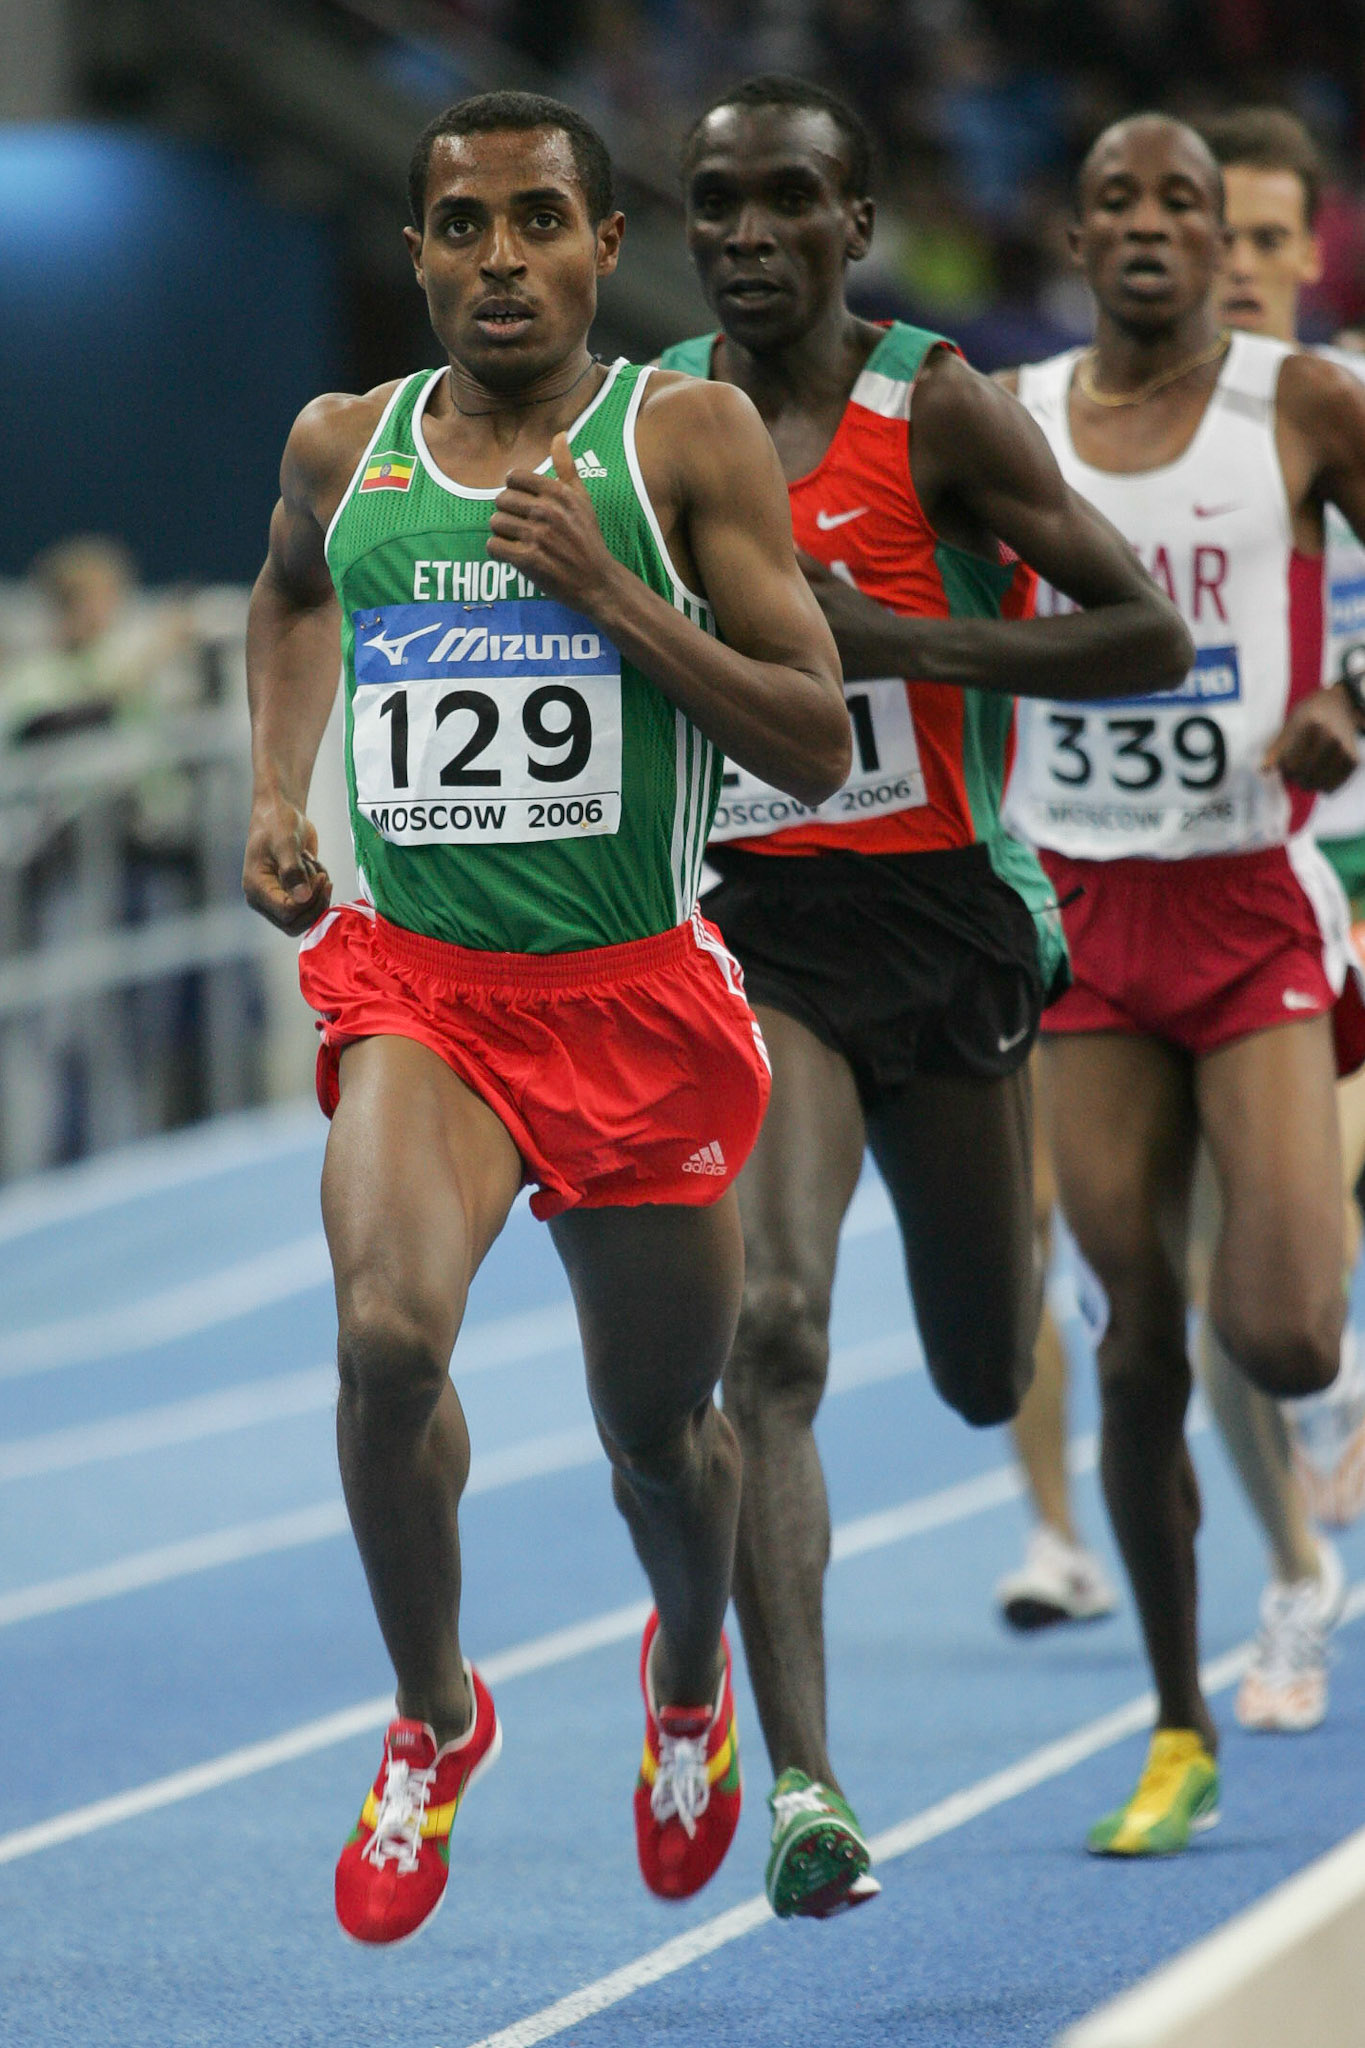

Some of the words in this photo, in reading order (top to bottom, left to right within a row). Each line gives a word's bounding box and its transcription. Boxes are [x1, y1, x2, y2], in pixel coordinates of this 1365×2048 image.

[413, 560, 546, 602] ETHIOPI
[379, 684, 593, 789] 129
[1049, 714, 1227, 793] 339
[840, 780, 911, 812] 2006
[371, 805, 506, 832] MOSCOW
[528, 800, 603, 829] 2006
[681, 1160, 728, 1176] adidas
